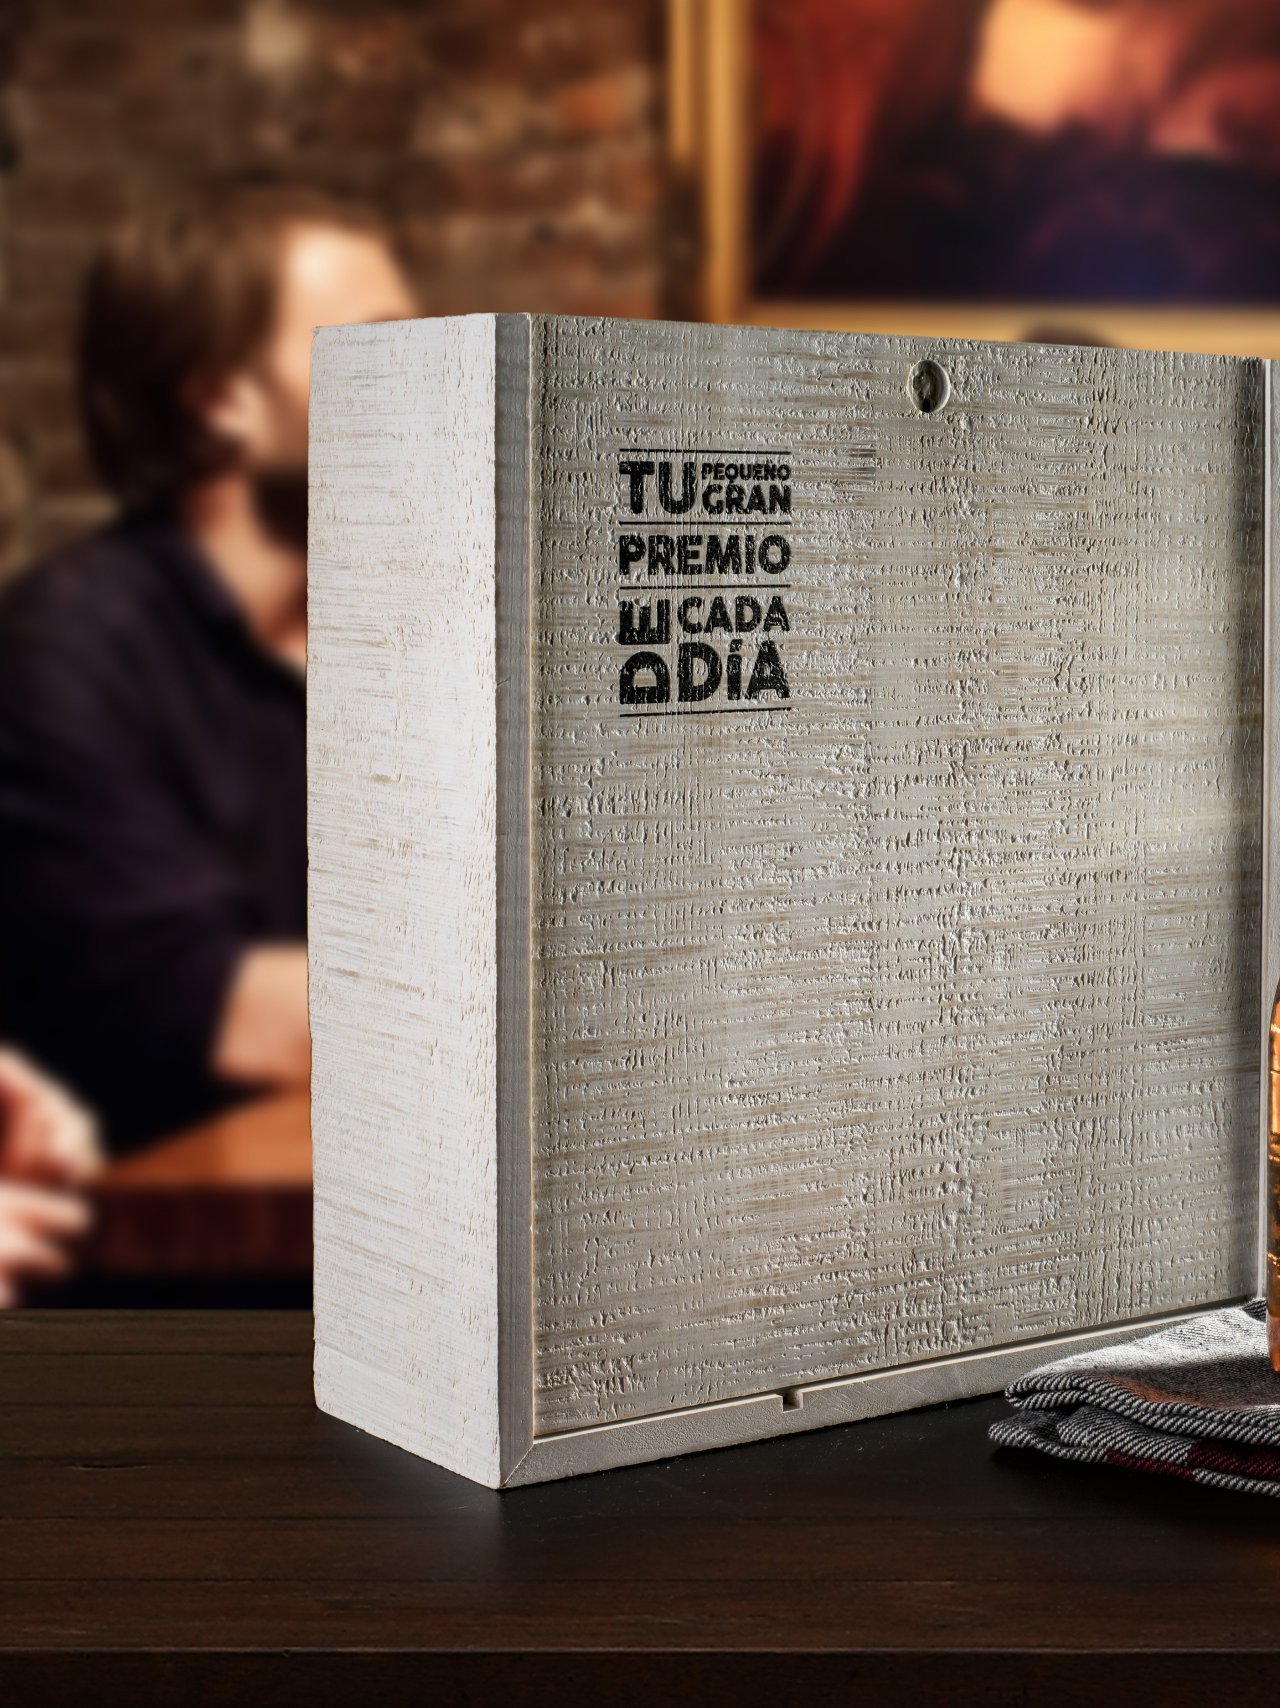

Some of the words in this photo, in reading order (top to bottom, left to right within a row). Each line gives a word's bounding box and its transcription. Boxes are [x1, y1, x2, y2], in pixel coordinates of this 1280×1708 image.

[618, 461, 695, 514] TU
[701, 484, 792, 515] GRAN
[618, 535, 791, 576] PREMIO
[677, 596, 790, 634] CADA
[618, 599, 671, 704] DE
